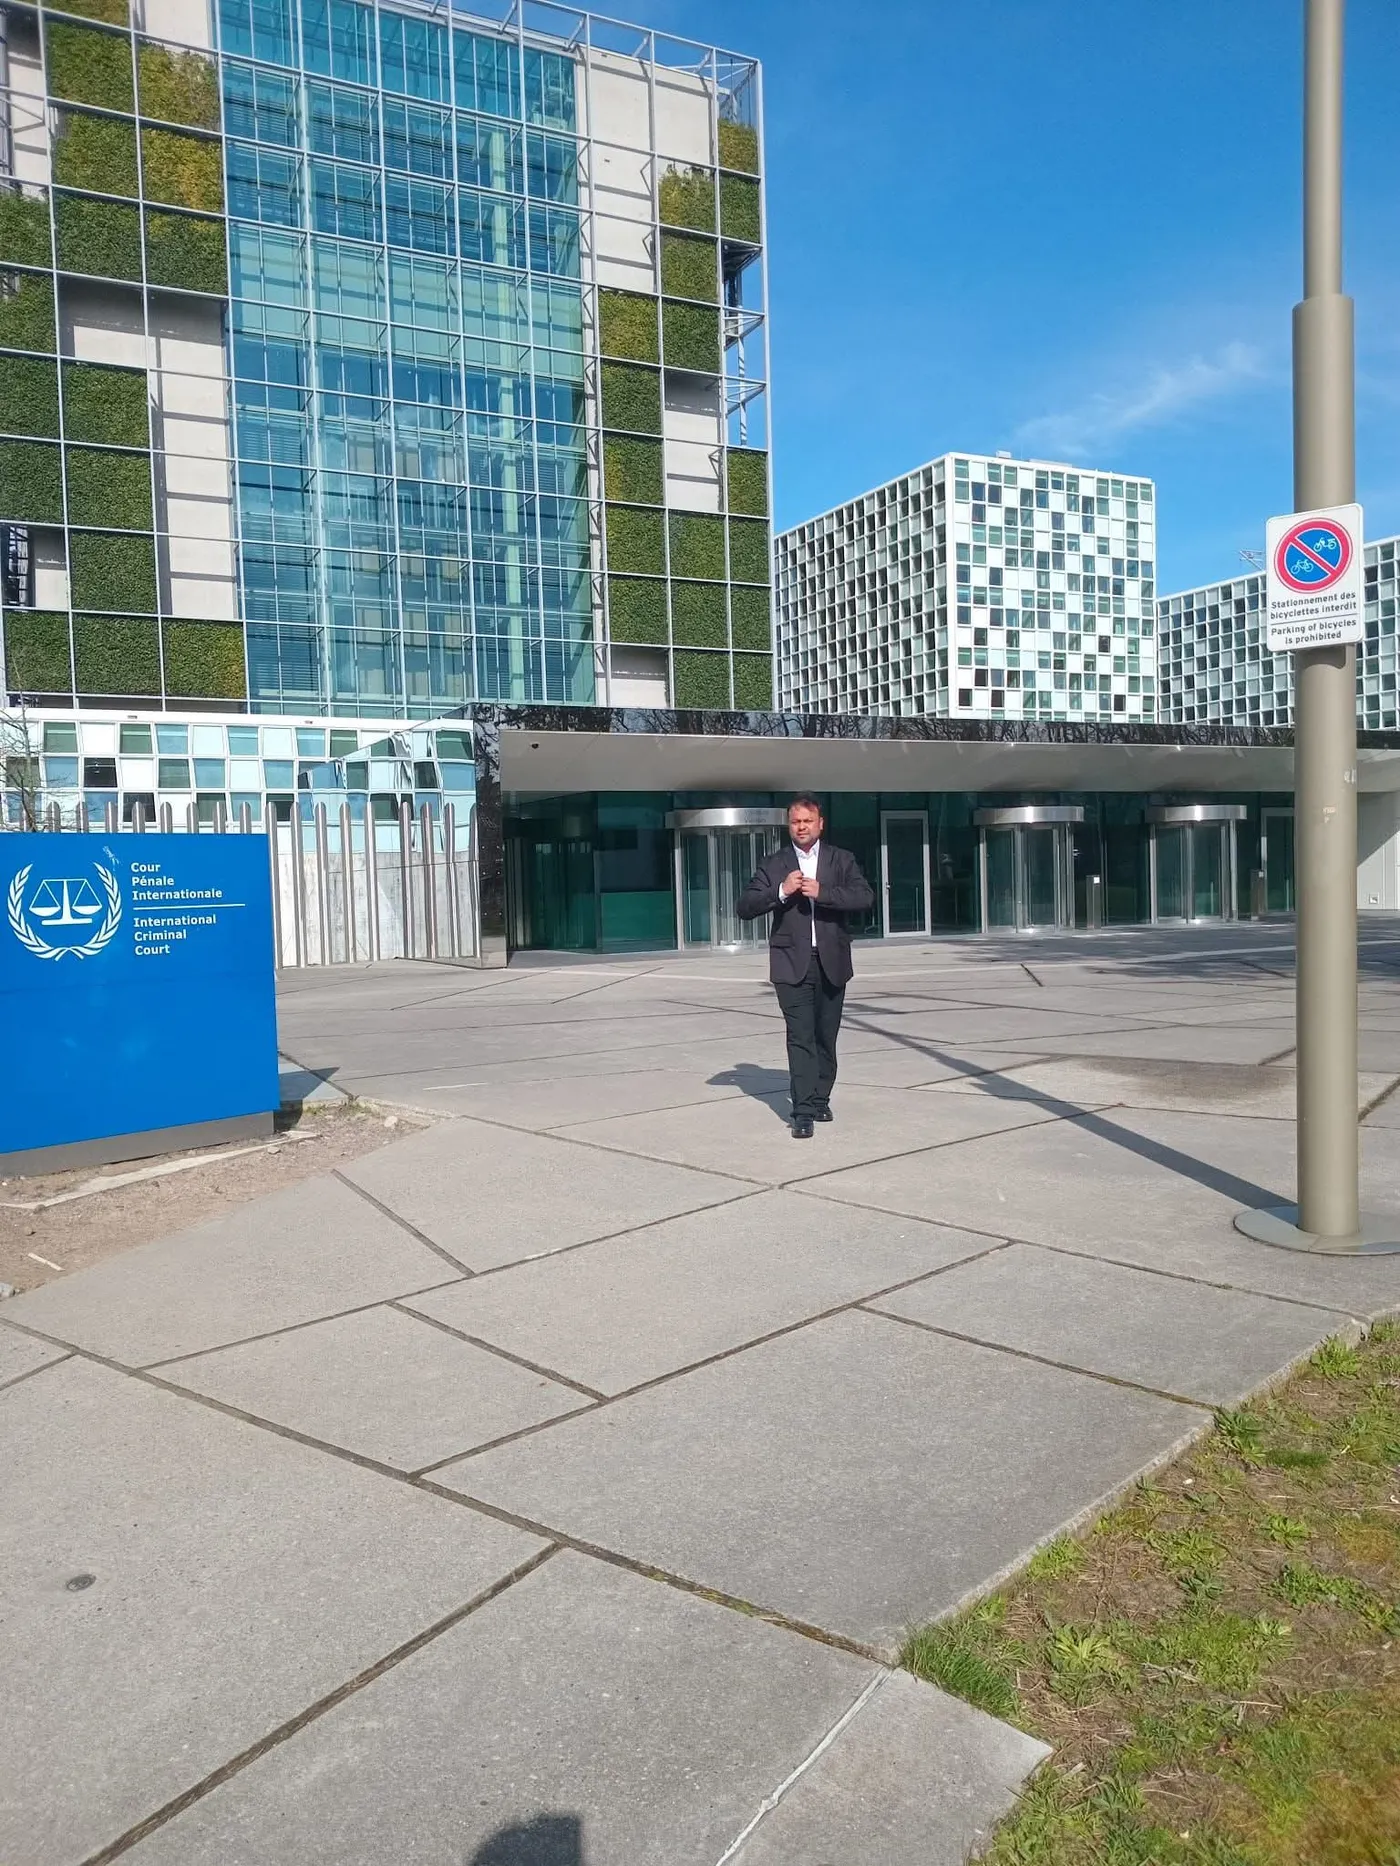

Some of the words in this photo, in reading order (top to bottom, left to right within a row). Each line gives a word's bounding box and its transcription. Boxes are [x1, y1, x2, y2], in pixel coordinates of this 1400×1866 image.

[1271, 593, 1338, 609] Stationnement
[1340, 591, 1356, 599] des
[1270, 606, 1320, 620] bicyclettes
[1321, 602, 1357, 613] interdit
[1271, 624, 1306, 636] Parking
[1308, 623, 1317, 631] of
[1319, 619, 1357, 631] bicycles
[1285, 636, 1293, 644] is
[1295, 630, 1342, 645] prohibited
[130, 862, 161, 873] Cour
[131, 875, 175, 887] Pénale
[132, 888, 223, 901] Internationale
[133, 914, 217, 928] International
[134, 929, 187, 941] Criminal
[135, 944, 171, 956] Court
